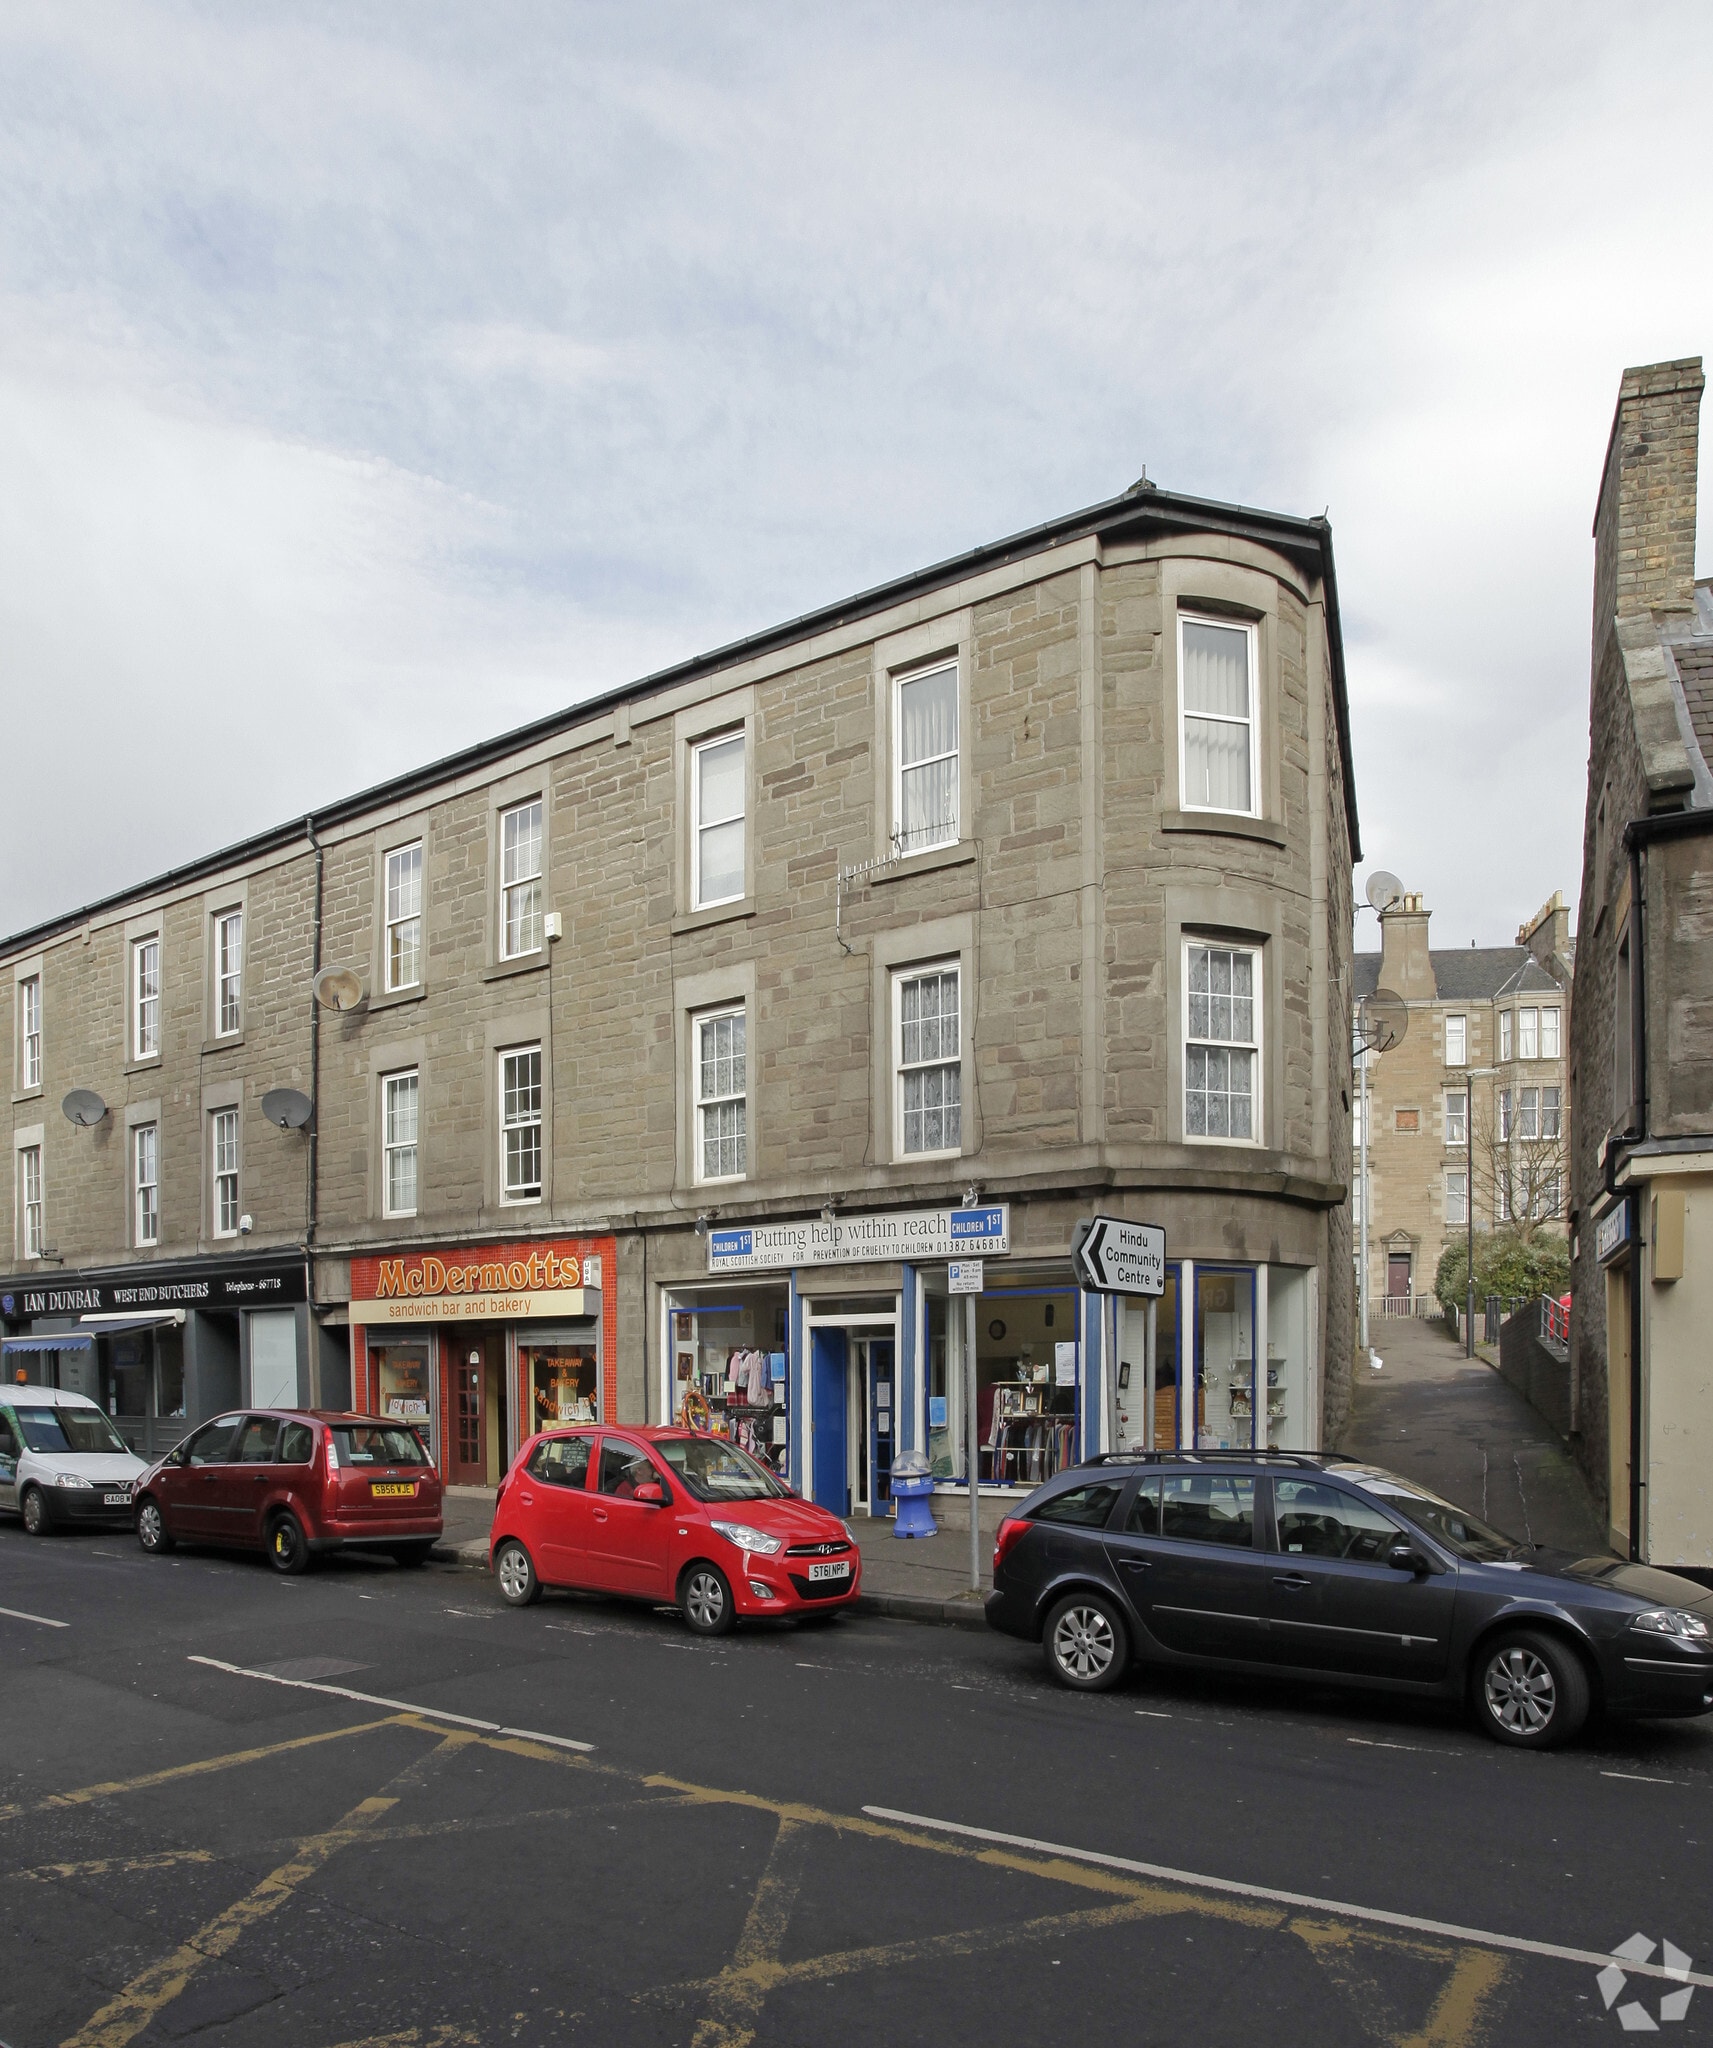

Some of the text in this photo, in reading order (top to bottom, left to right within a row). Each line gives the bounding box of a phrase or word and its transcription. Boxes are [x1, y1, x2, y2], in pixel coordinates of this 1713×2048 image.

[755, 1213, 947, 1250] Putting help within reach
[952, 1213, 1001, 1234] CHILDREN 1ST
[712, 1234, 751, 1253] CHILDREN 1ST
[1120, 1229, 1148, 1247] Hindu
[711, 1237, 1007, 1268] ROYAL SCOTTISH SOCIETY FOR PREVENTION OF CRUELTY TO CHILDREN 01382 646816
[1106, 1246, 1161, 1270] Community
[376, 1250, 581, 1298] McDermotts
[952, 1266, 959, 1278] P
[1117, 1267, 1150, 1285] Centre
[113, 1282, 209, 1304] WEST END BUTCHERS
[225, 1281, 255, 1294] Telephone
[24, 1288, 101, 1312] IAN DUNBAR
[389, 1298, 531, 1317] sandwich bar and bakery
[547, 1358, 583, 1367] TAKEAWAY
[561, 1368, 568, 1377] &
[550, 1378, 579, 1388] BAKERY
[533, 1386, 580, 1415] sandwich
[375, 1485, 396, 1494] SB56
[105, 1495, 125, 1503] SA08
[832, 1563, 845, 1575] NPF
